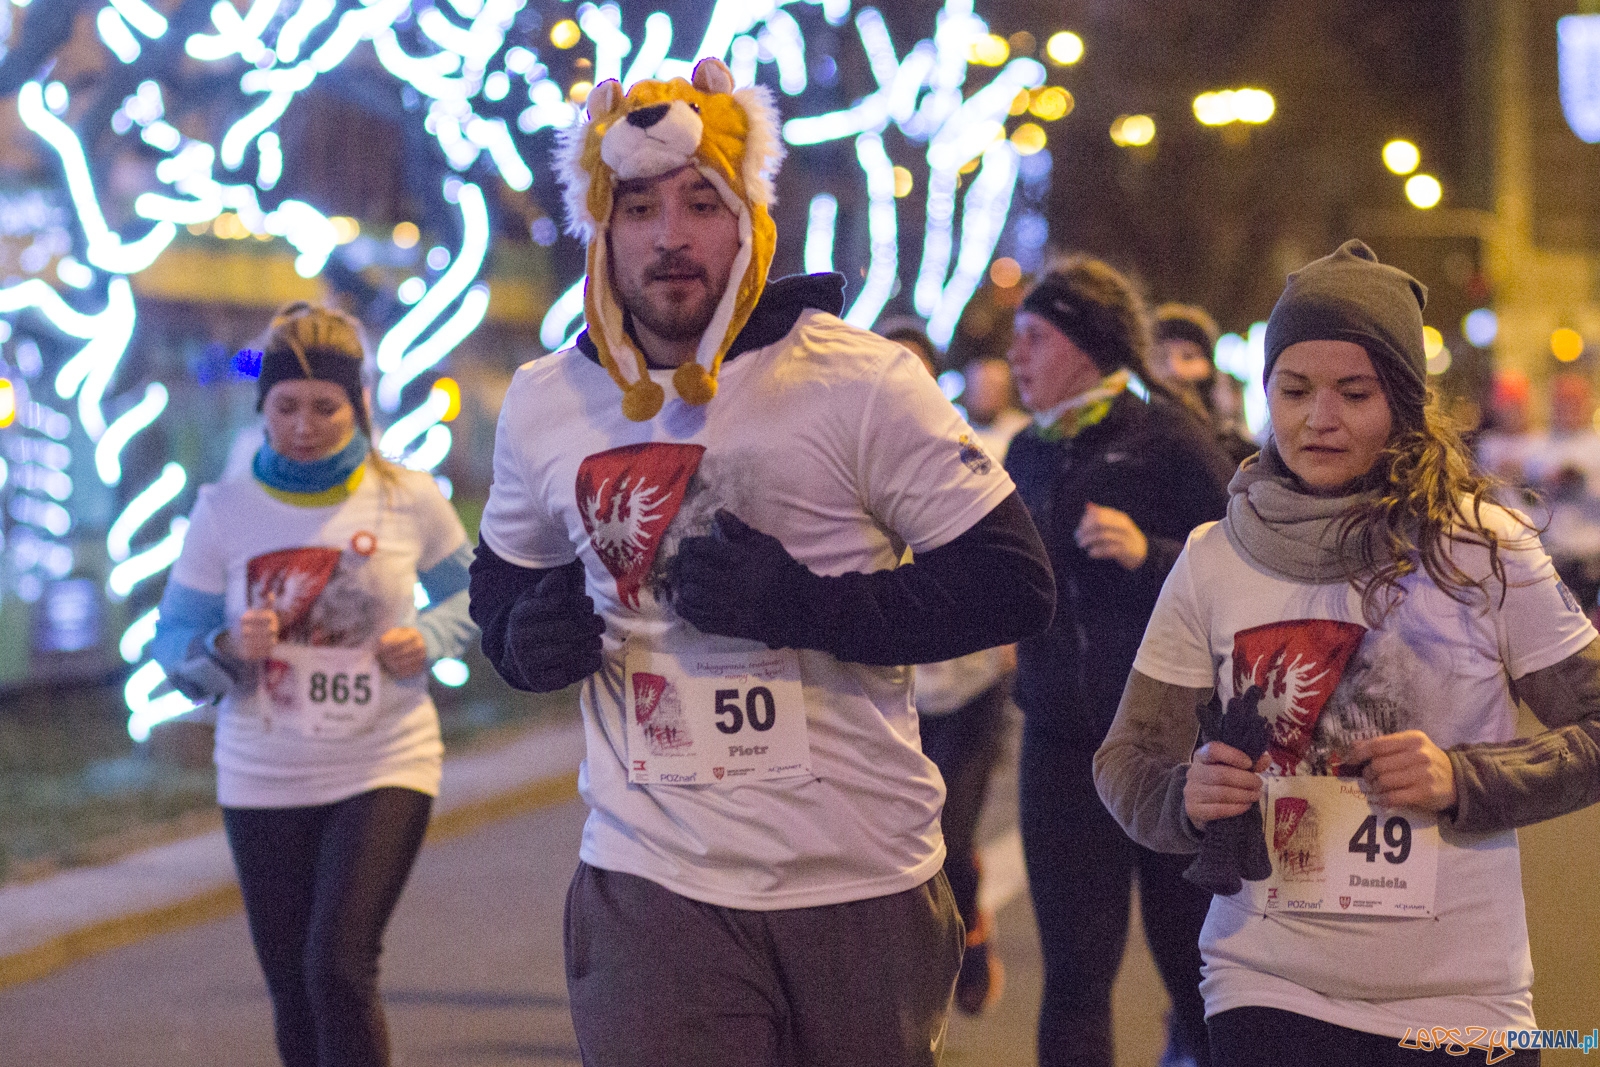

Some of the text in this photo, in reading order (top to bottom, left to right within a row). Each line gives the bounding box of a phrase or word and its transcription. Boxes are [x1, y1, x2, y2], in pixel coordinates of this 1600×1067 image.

[309, 671, 372, 705] 865
[714, 686, 776, 735] 50
[728, 745, 769, 757] Piotr
[1348, 815, 1412, 865] 49
[1348, 874, 1408, 889] Daniela
